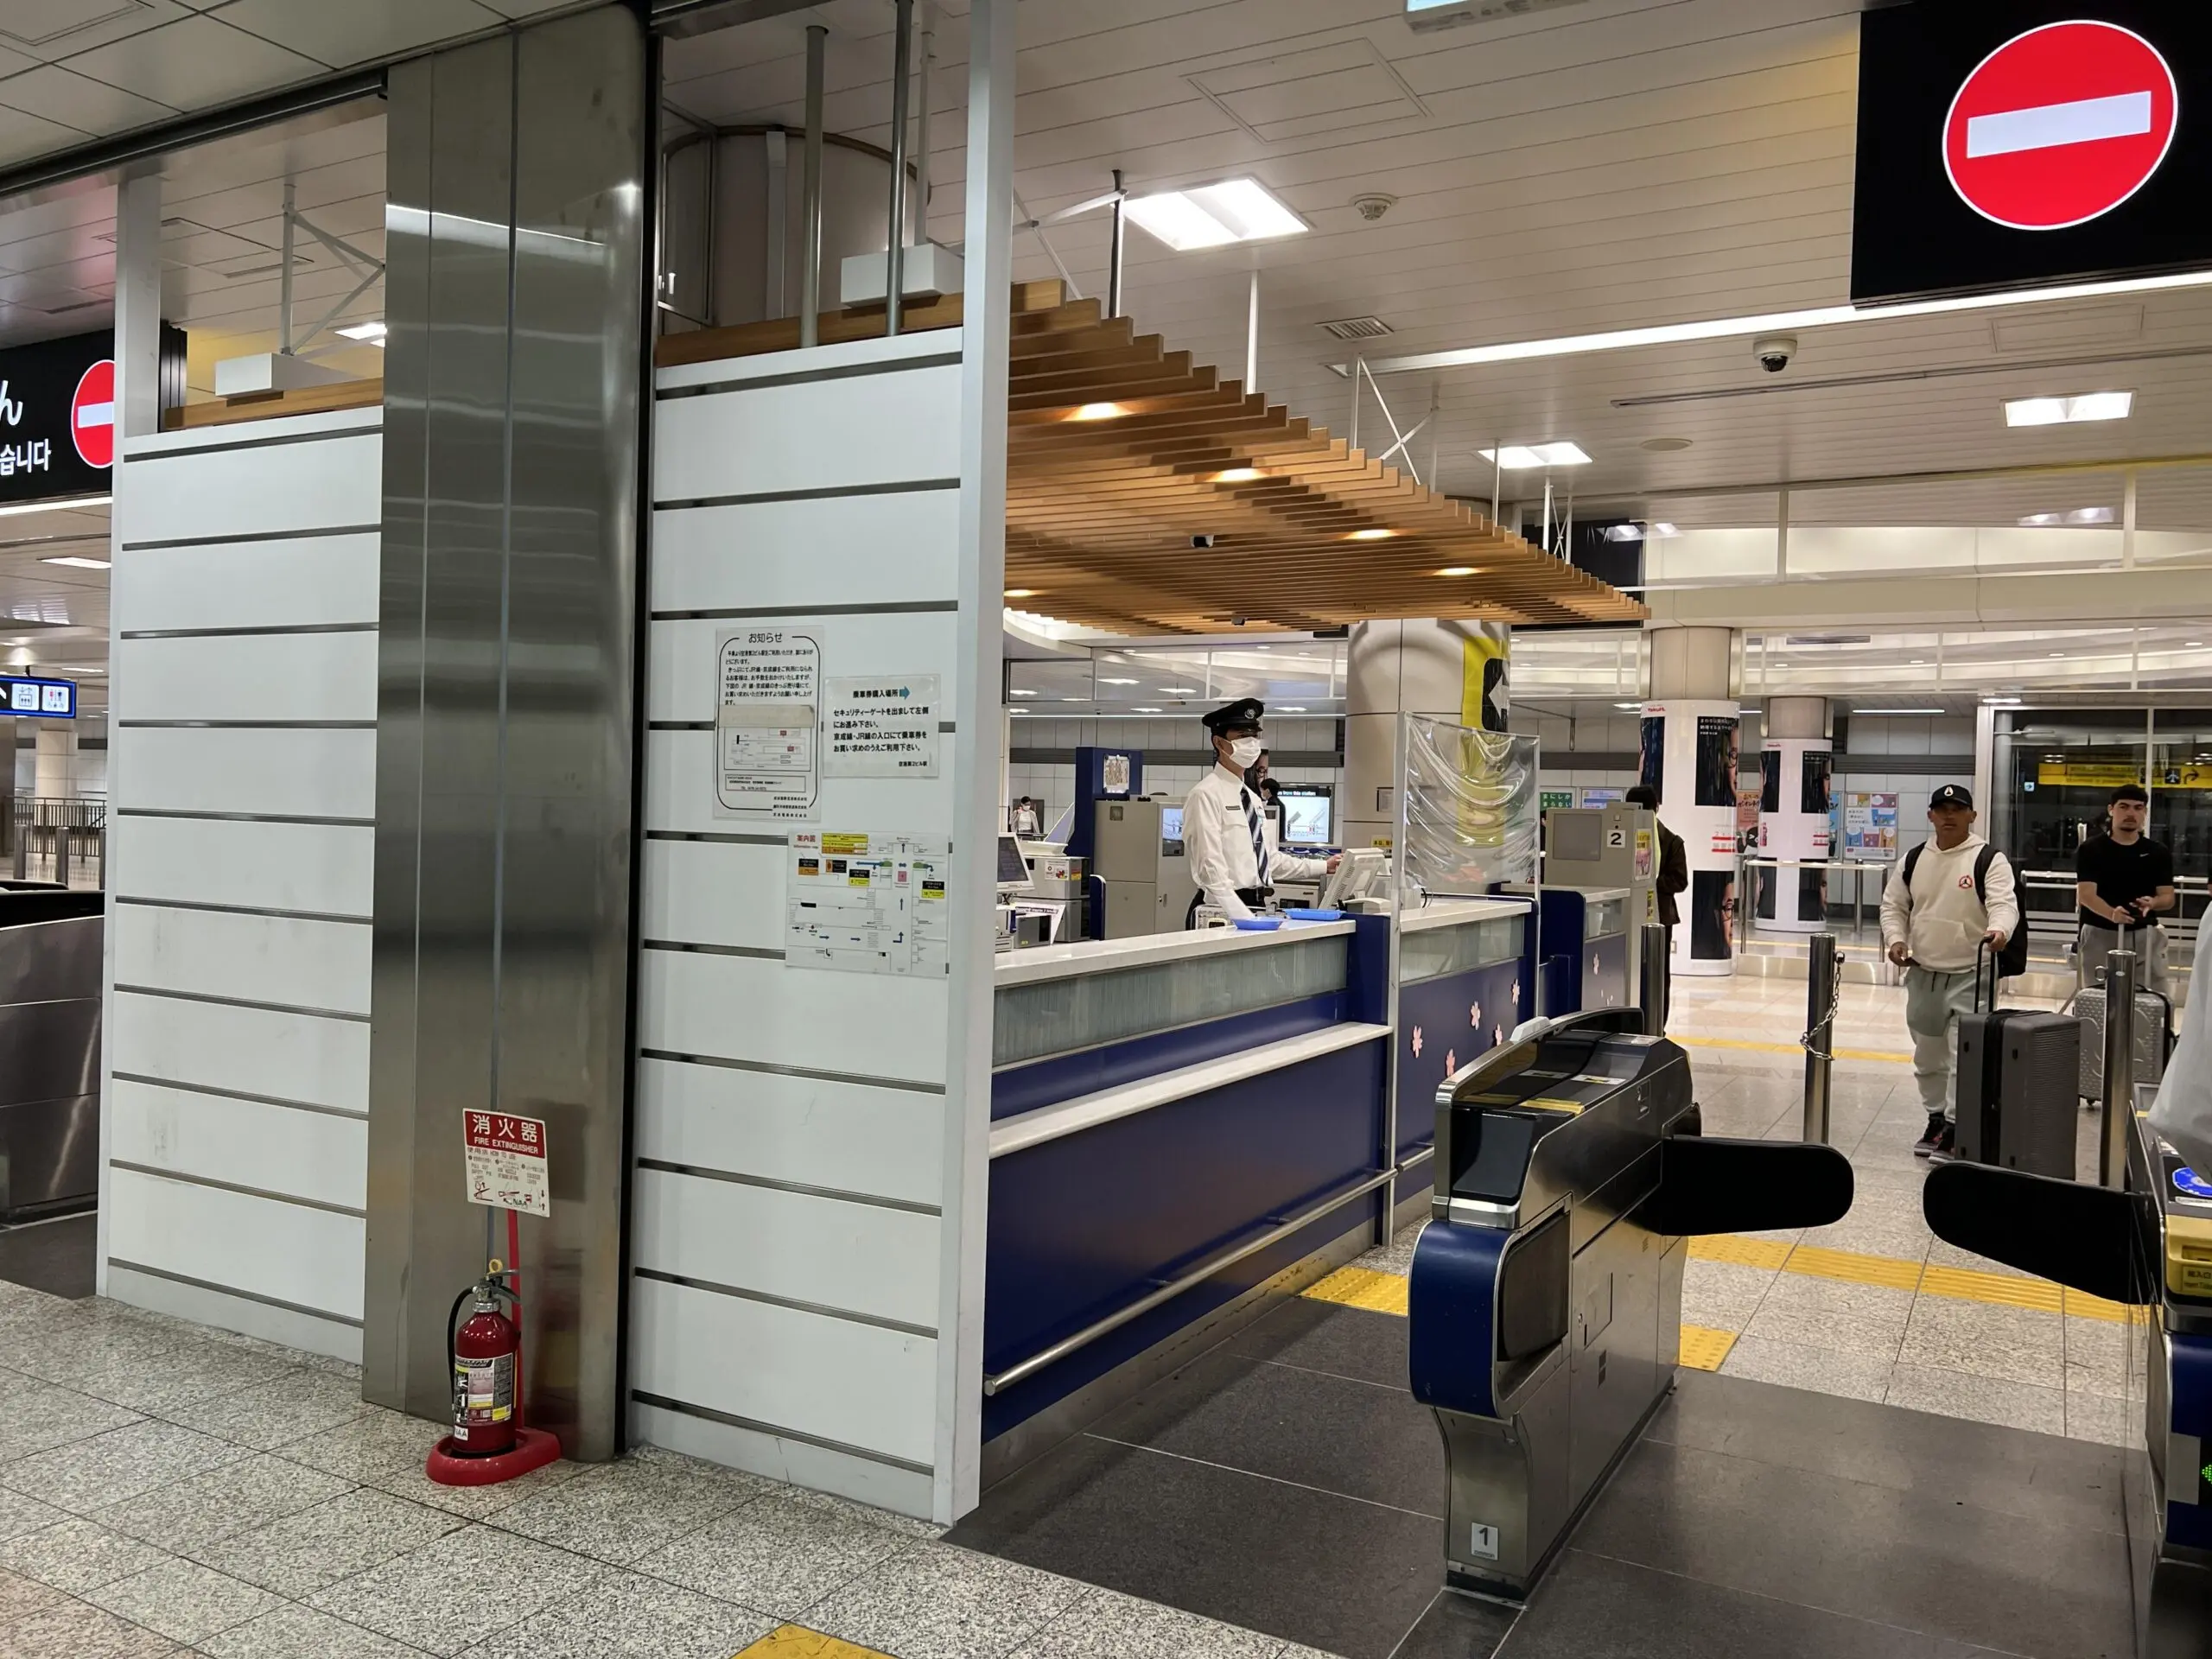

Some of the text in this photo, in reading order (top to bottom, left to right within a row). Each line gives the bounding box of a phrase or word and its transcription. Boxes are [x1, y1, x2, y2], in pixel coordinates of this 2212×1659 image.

[748, 632, 783, 644] お知らせ
[853, 689, 899, 698] 乗車券購入場所
[833, 706, 929, 717] セキュリティーゲートを出まして左側
[1610, 832, 1622, 846] 2
[473, 1114, 537, 1143] 消火器
[474, 1136, 538, 1154] FIRE EXTINGUISHER
[1478, 1527, 1488, 1547] 1
